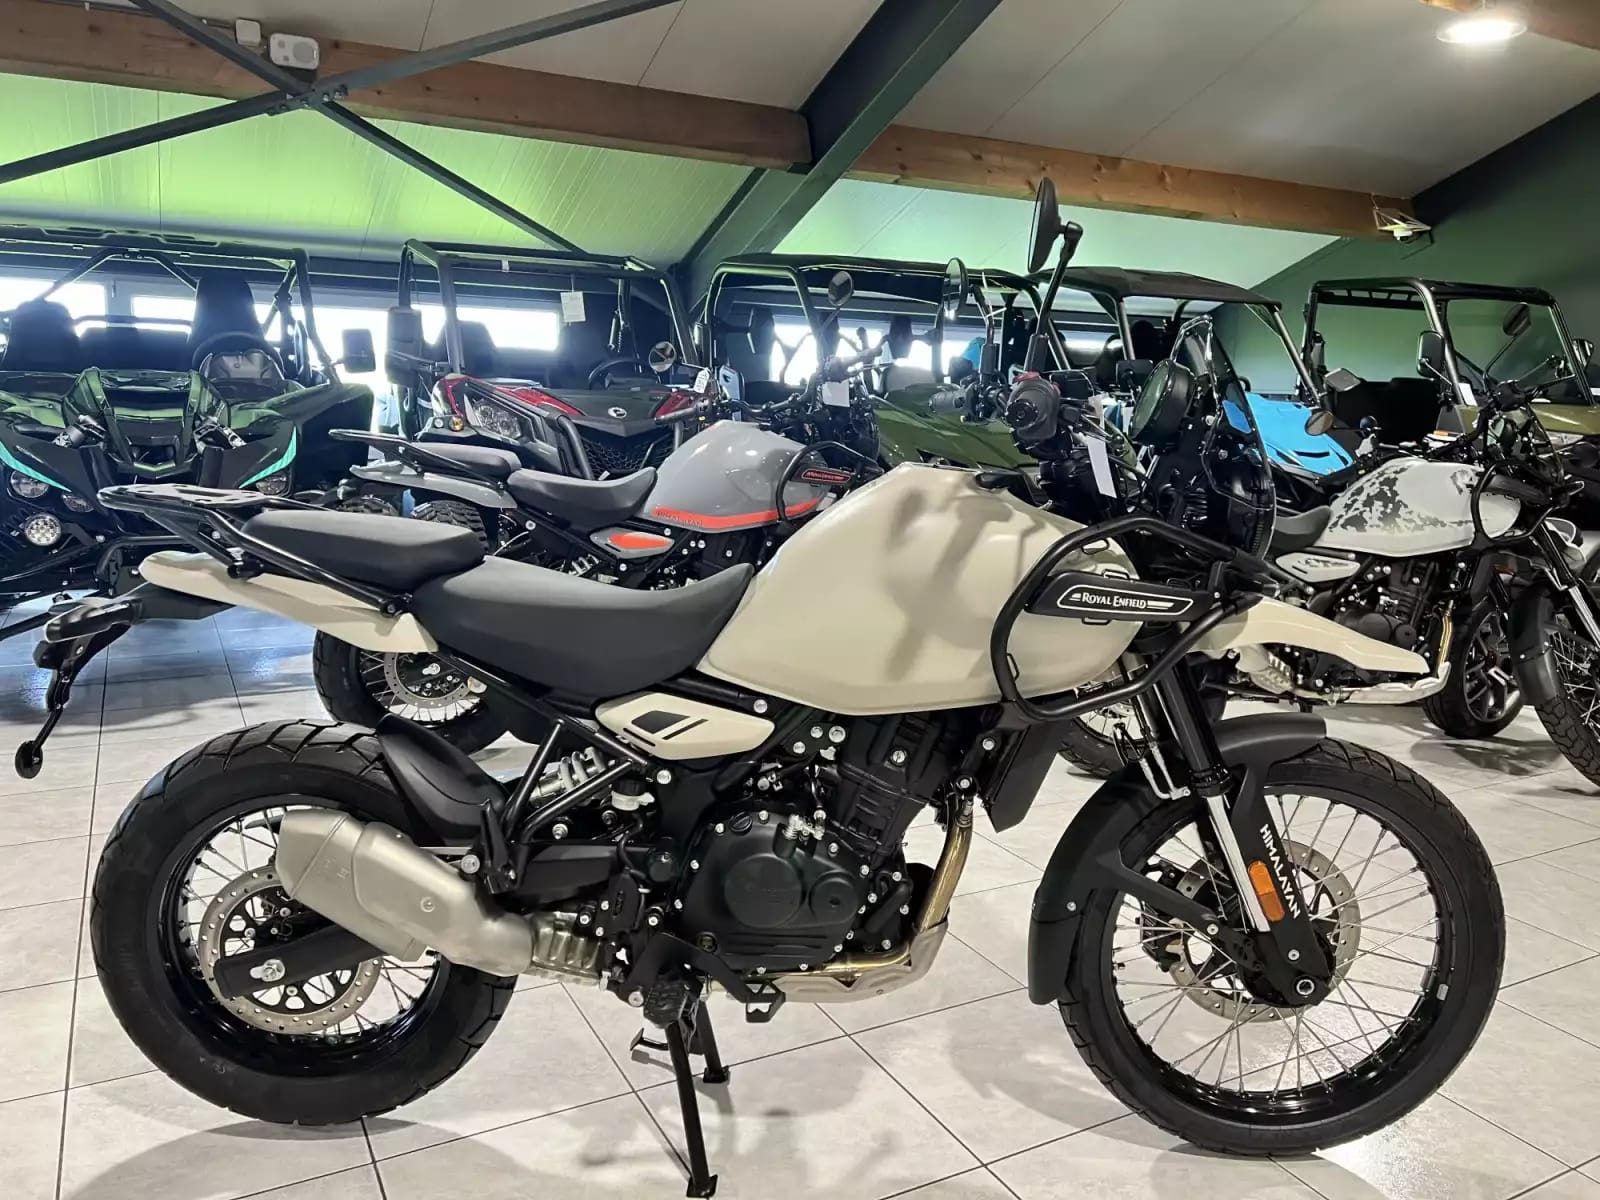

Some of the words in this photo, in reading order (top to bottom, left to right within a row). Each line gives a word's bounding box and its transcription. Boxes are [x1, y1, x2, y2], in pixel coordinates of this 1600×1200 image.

[1082, 592, 1112, 604] ROYAL
[1113, 595, 1146, 609] ENFIELD
[1260, 824, 1300, 918] HIMALAYAN
